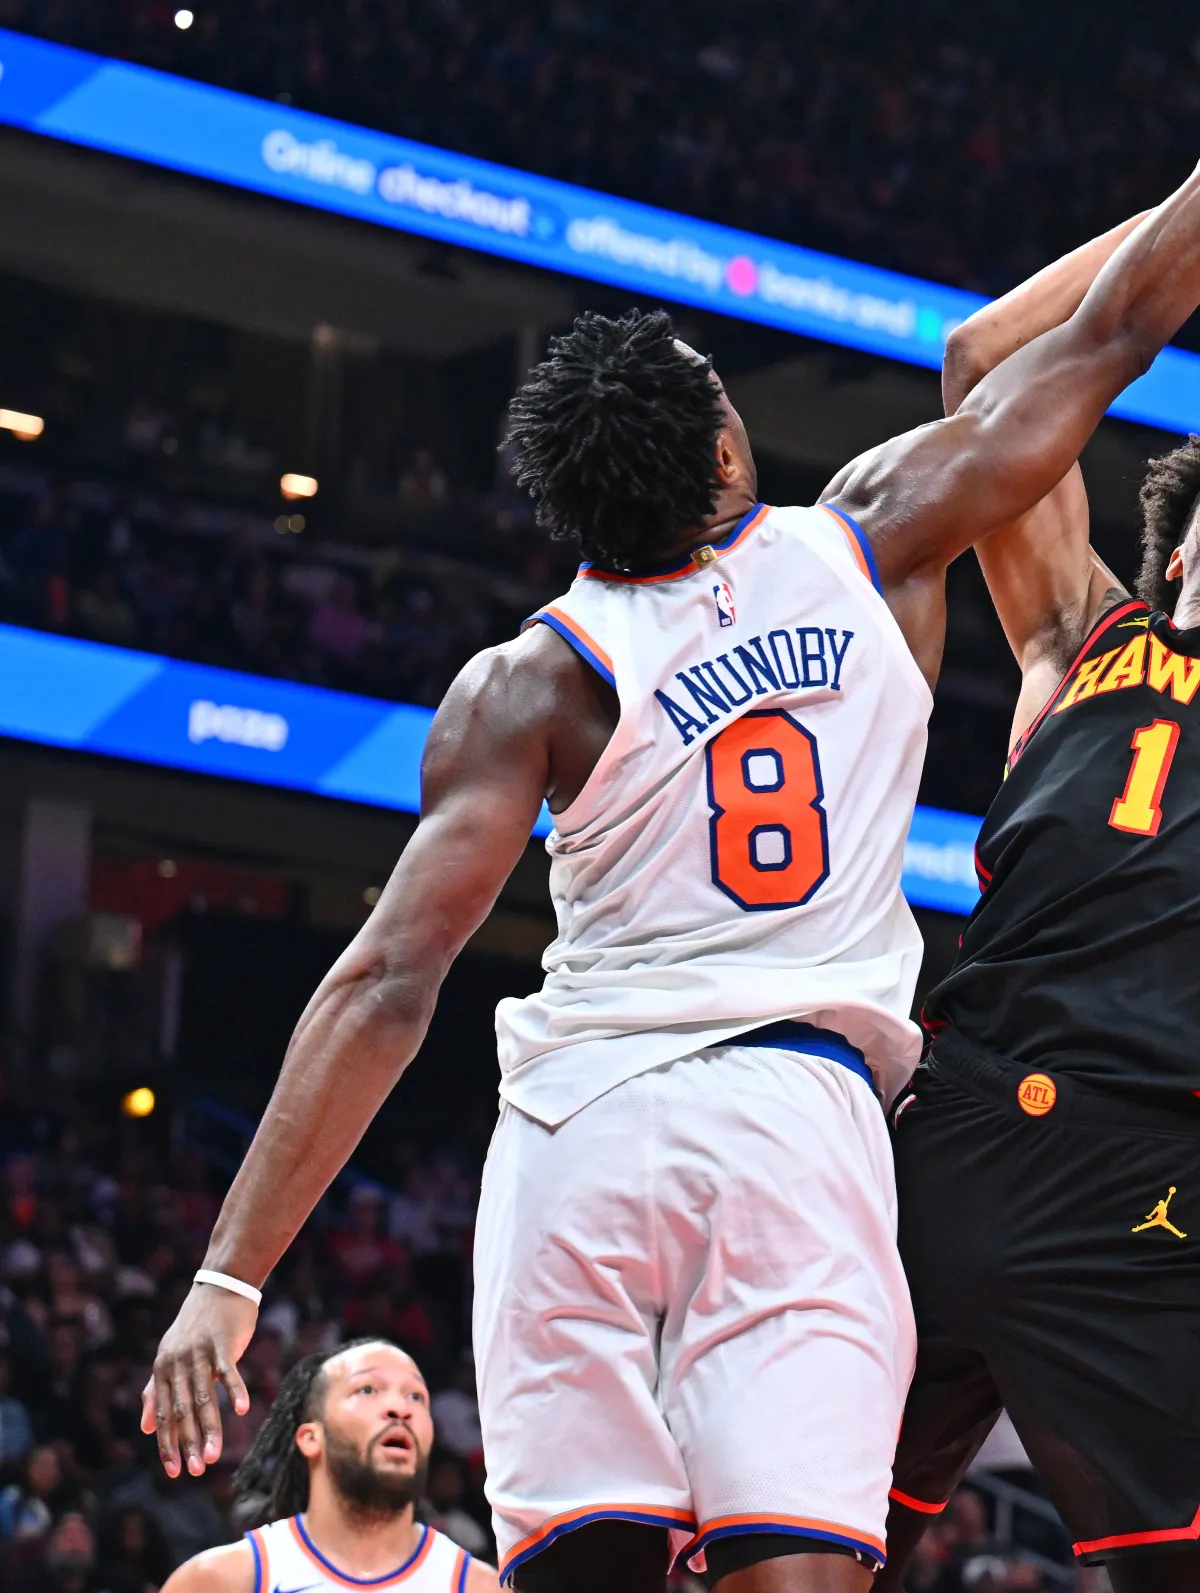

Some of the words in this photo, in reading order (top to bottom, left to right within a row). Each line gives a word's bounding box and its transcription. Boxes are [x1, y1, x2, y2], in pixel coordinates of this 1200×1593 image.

[653, 627, 854, 746] ANUNOBY
[704, 708, 830, 912] 8
[1108, 718, 1181, 836] 1
[1022, 1084, 1049, 1105] ATL
